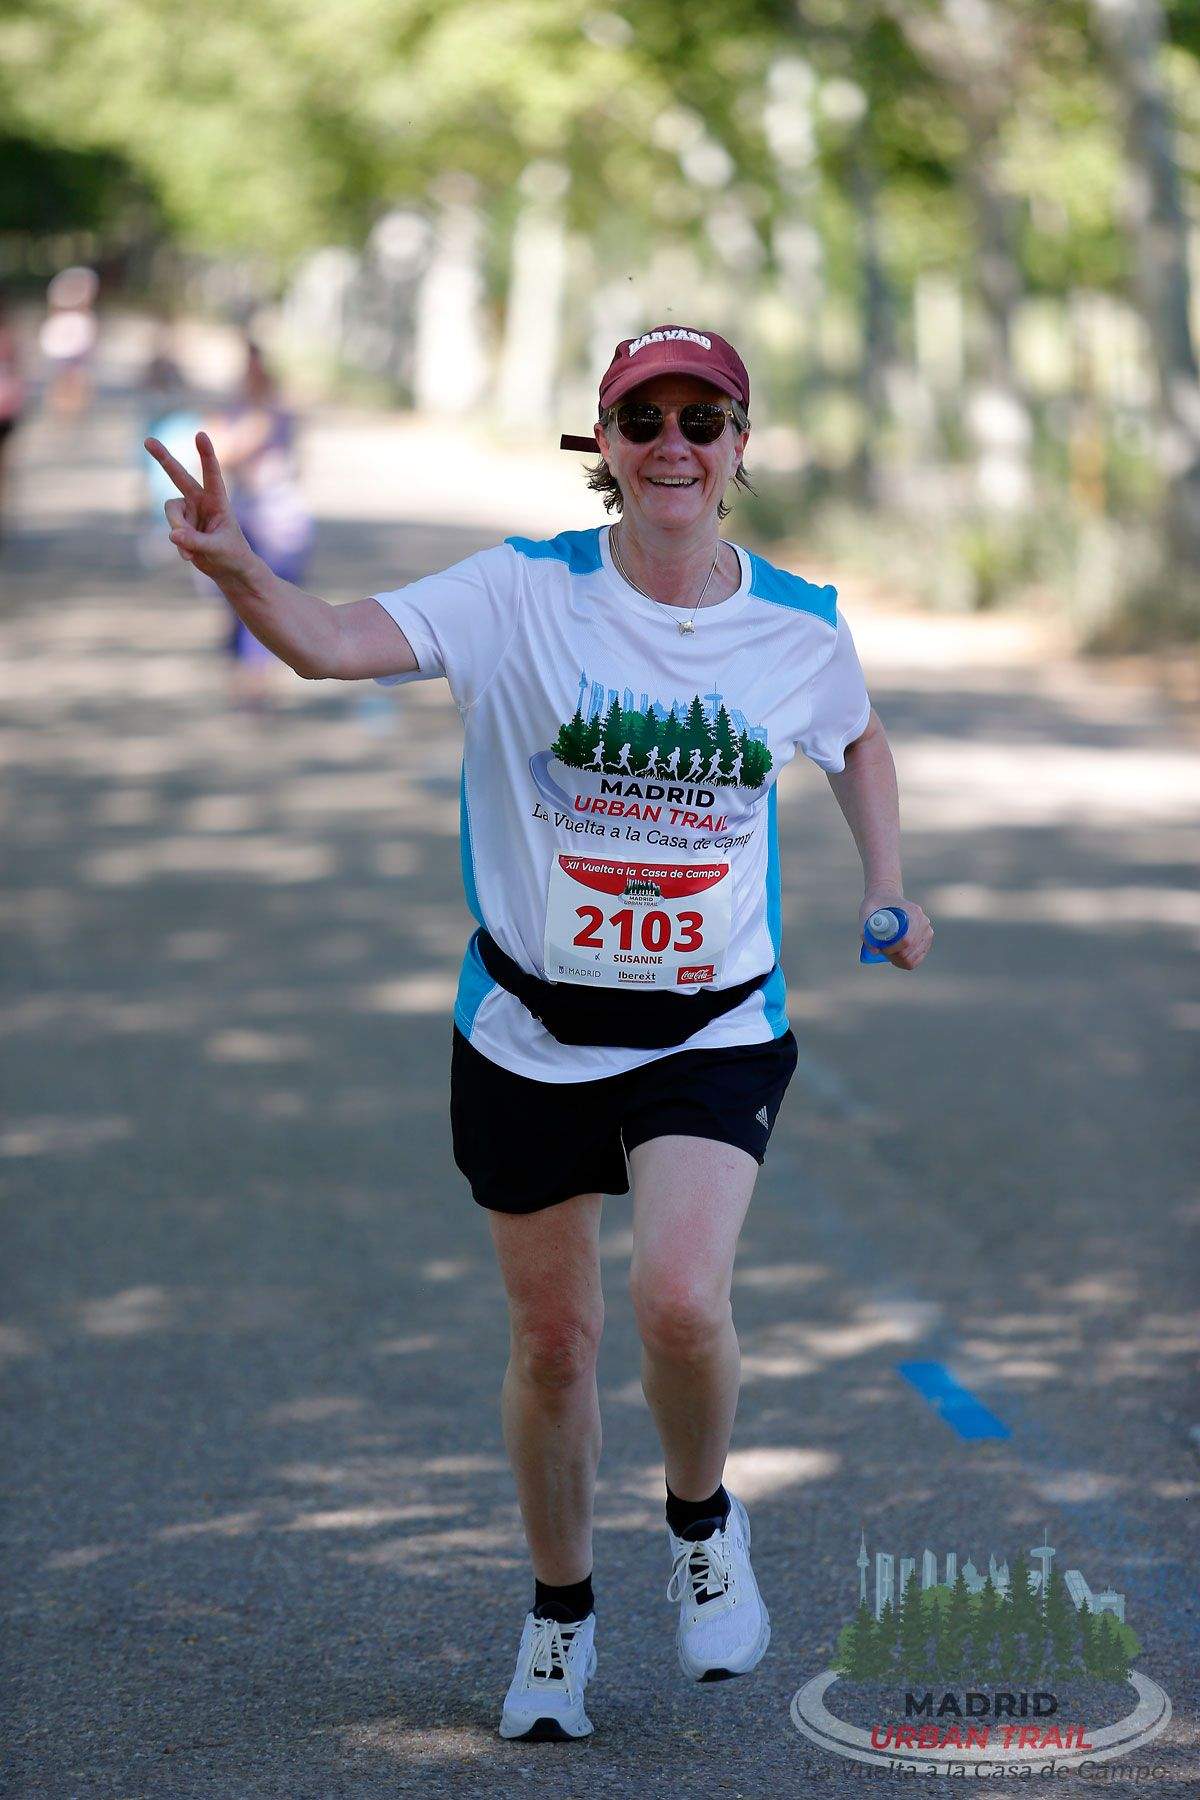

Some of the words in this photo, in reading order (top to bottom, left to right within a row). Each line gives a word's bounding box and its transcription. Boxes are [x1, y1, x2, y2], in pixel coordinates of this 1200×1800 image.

[600, 778, 716, 808] MADRID
[532, 803, 550, 822] La
[554, 812, 605, 836] Vuelta
[609, 827, 621, 838] a
[626, 826, 640, 842] la
[646, 830, 687, 849] Casa
[693, 838, 711, 850] de
[714, 830, 755, 849] Camp
[573, 795, 663, 823] URBAN
[670, 808, 728, 833] TRAIL
[565, 860, 580, 870] XII
[582, 862, 615, 875] Vuelta
[616, 867, 624, 875] a
[626, 867, 636, 876] la
[641, 868, 668, 878] Casa
[669, 868, 684, 878] de
[685, 869, 721, 880] Campo
[573, 905, 704, 953] 2103
[613, 954, 663, 965] SUSANNE
[568, 968, 602, 978] MADRID
[618, 971, 656, 981] Iberext
